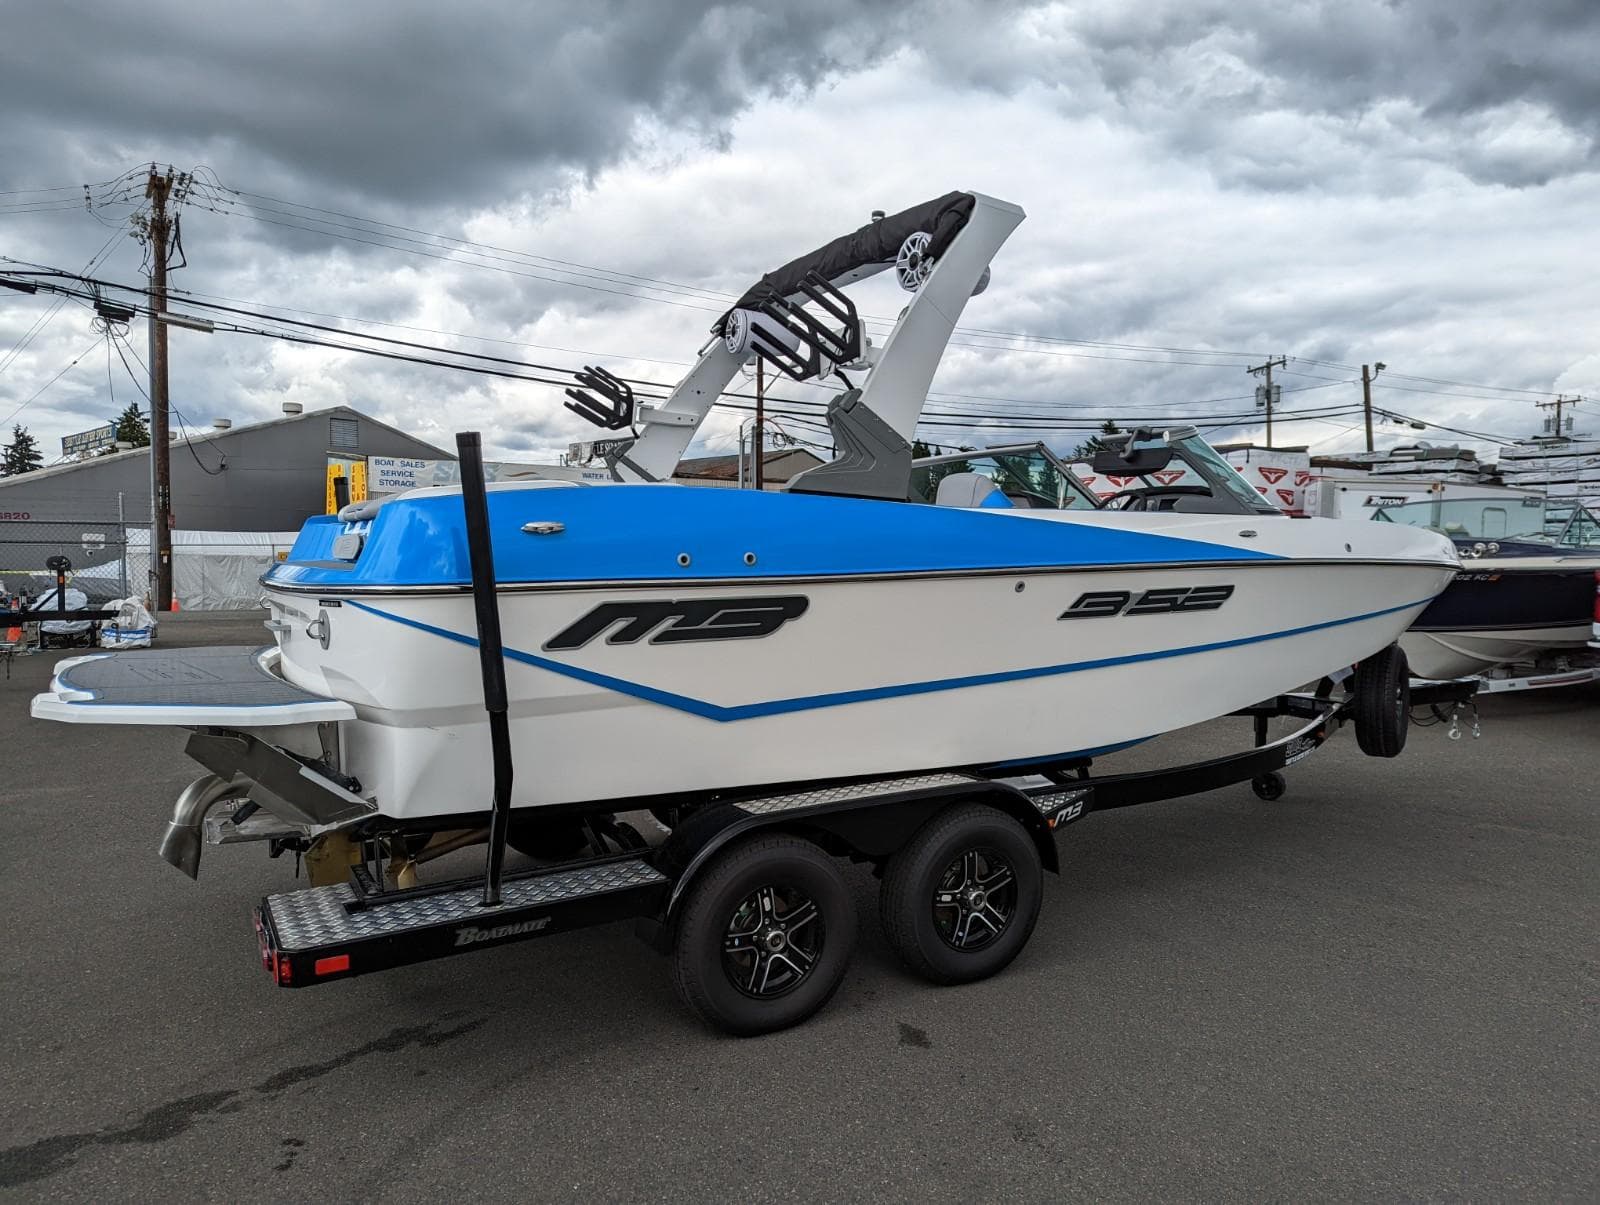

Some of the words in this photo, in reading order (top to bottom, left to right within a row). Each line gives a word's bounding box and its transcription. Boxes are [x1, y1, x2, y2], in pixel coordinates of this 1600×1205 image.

[400, 461, 426, 469] SALES
[380, 469, 415, 478] SERVICE
[582, 472, 604, 480] WATER
[378, 479, 417, 488] STORAGE
[1057, 585, 1235, 621] B52
